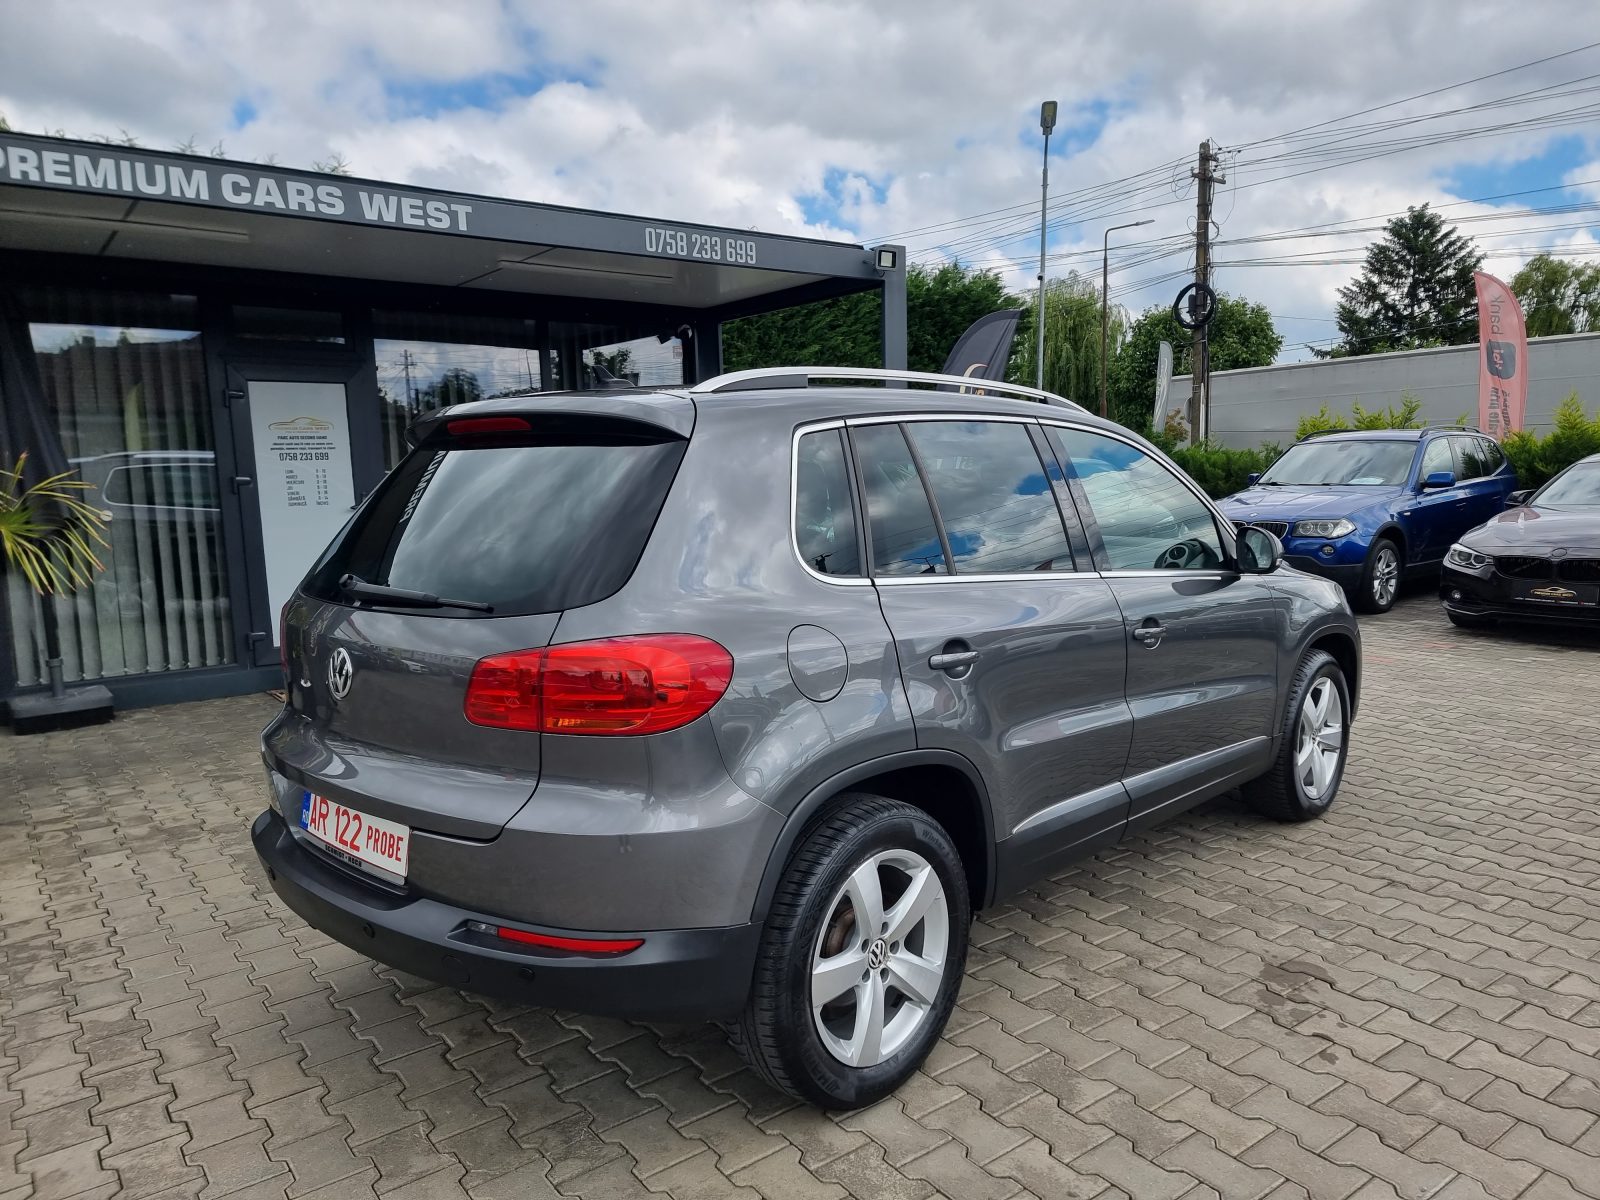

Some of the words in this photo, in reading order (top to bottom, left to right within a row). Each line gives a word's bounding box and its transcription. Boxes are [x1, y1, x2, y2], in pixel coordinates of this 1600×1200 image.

[220, 173, 345, 216] CARS
[358, 190, 473, 232] WEST
[645, 227, 688, 256] 0758
[691, 233, 721, 260] 233
[726, 238, 757, 265] 699
[279, 452, 298, 461] 0758
[299, 452, 313, 461] 233
[314, 452, 329, 461] 699
[309, 795, 330, 836] AR
[335, 805, 363, 853] 122
[366, 824, 404, 862] PROBE
